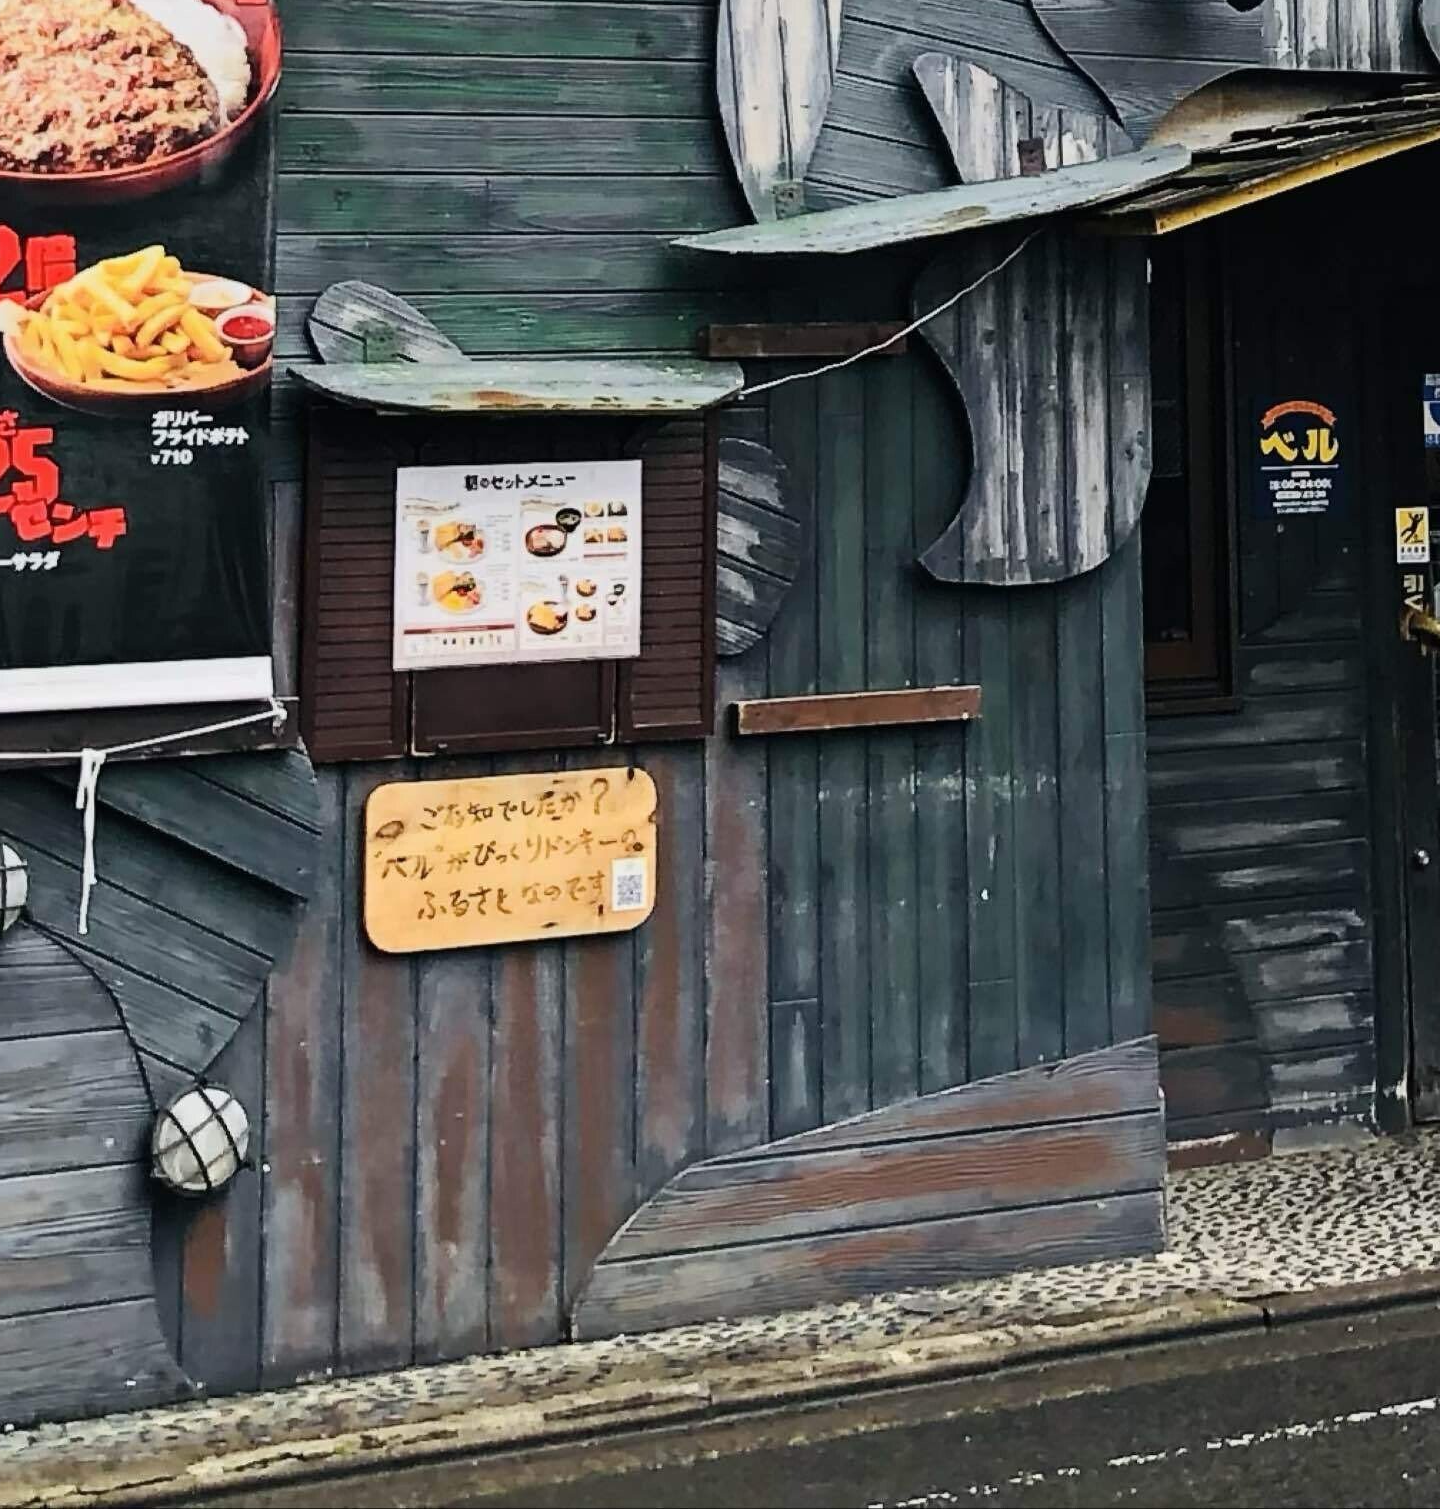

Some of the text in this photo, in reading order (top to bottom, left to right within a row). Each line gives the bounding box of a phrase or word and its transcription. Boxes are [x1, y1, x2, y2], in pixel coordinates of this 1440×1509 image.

[151, 409, 213, 428] ガリバー
[152, 426, 249, 446] フライドポテト
[1260, 428, 1339, 463] ベル
[150, 448, 194, 465] ¥710
[11, 500, 127, 549] センチ
